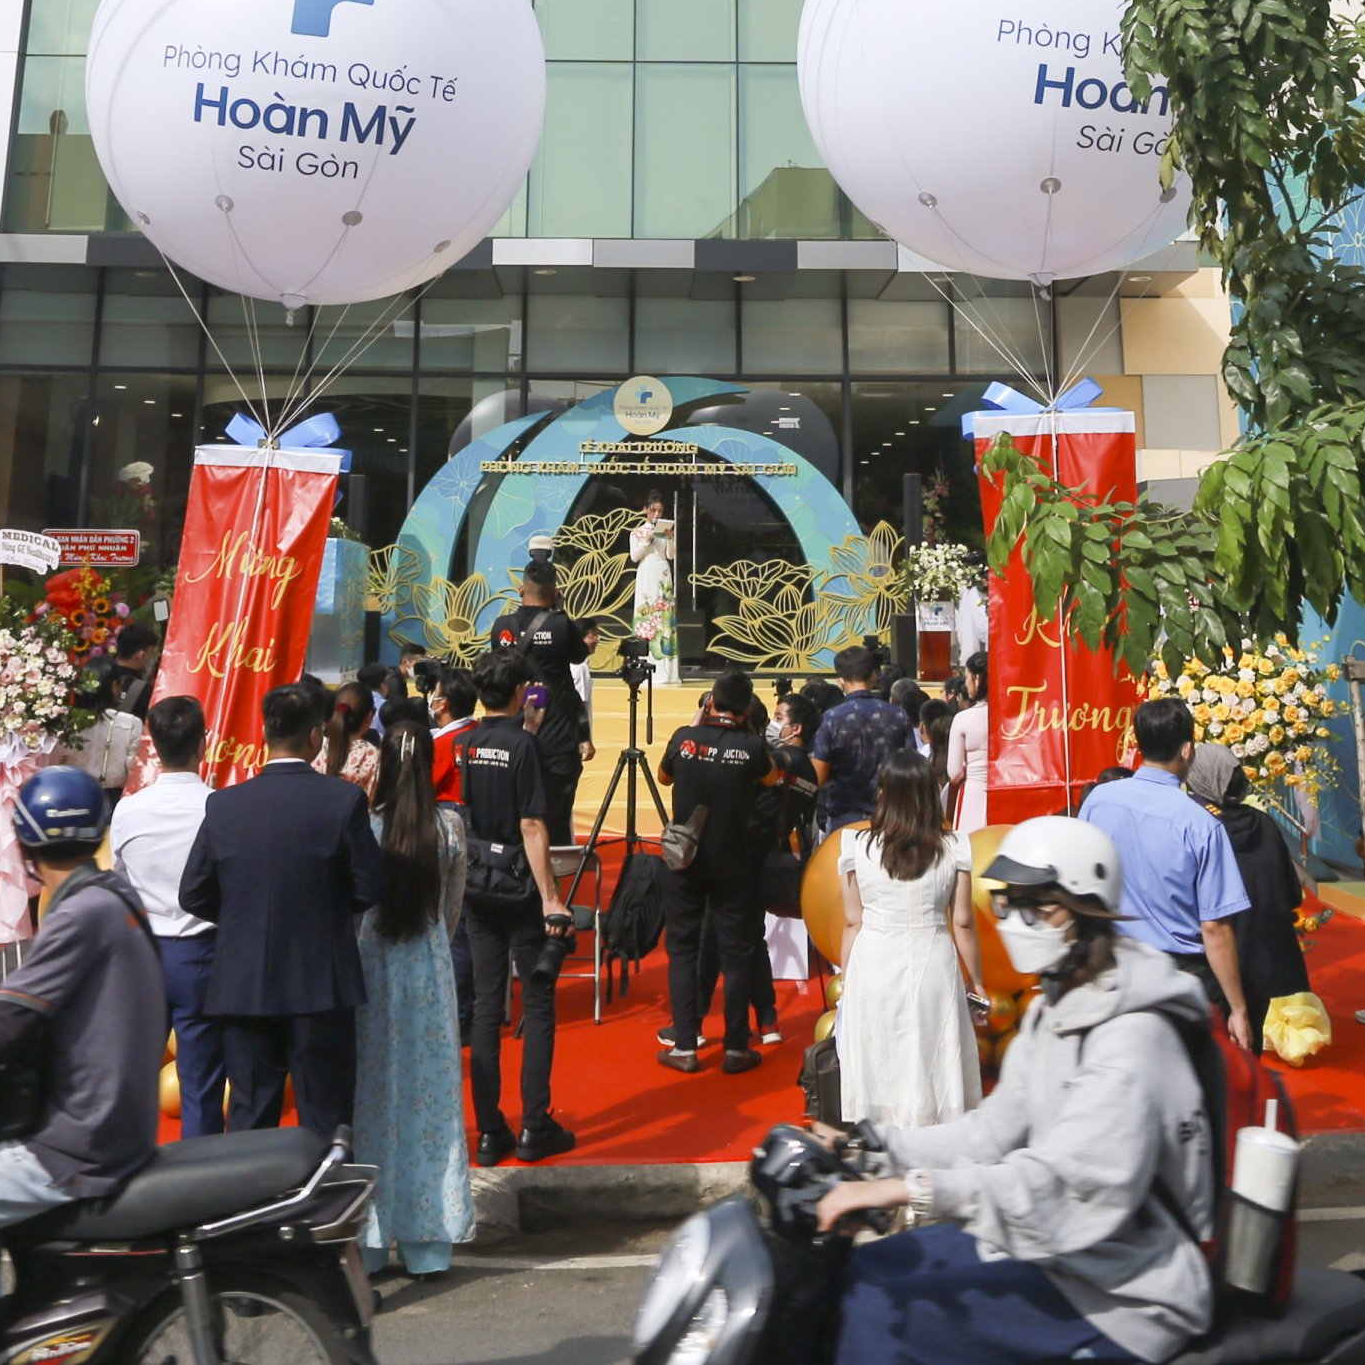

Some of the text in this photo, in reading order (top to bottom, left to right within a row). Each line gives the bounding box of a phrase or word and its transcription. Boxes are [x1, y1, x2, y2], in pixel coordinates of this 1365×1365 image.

[997, 18, 1092, 59] Phòng
[163, 44, 459, 103] Phòng Khám Quốc Tế
[193, 81, 418, 156] Hoàn Mỹ
[1076, 124, 1126, 153] Sài
[237, 145, 360, 180] Sài Gòn
[598, 440, 633, 453] KHAI
[2, 531, 59, 553] MEDICAL
[186, 529, 303, 611] Mừng
[186, 616, 278, 678] Khai
